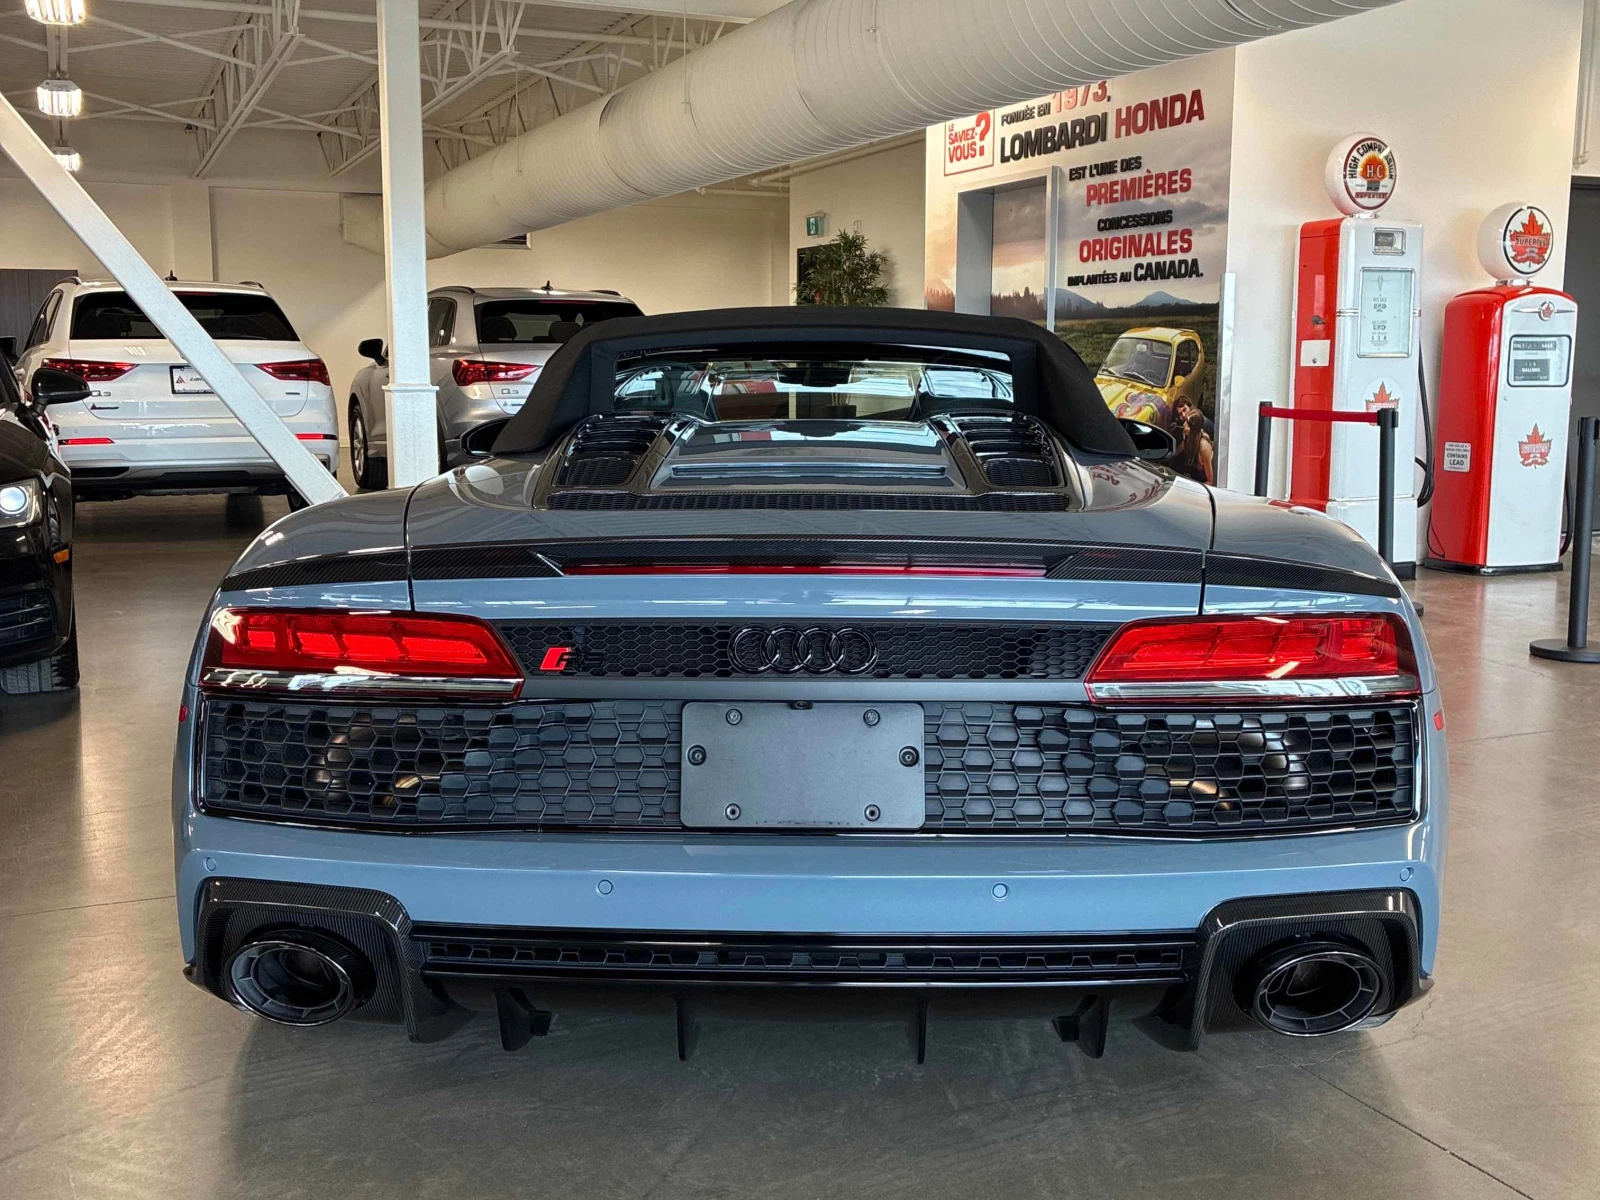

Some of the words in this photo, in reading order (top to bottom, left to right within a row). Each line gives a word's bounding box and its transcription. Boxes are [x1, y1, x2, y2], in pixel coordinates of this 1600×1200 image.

[1001, 105, 1036, 126] FONDÉE
[1037, 102, 1051, 118] EN
[948, 124, 955, 132] LE
[948, 127, 978, 145] SAVIEZ-
[1000, 112, 1108, 164] LOMBARDI
[1114, 89, 1205, 139] HONDA
[948, 141, 977, 163] VOUS
[1069, 165, 1088, 181] EST
[1089, 160, 1118, 177] L'UNE
[1120, 155, 1142, 173] DES
[1348, 155, 1361, 179] HIGH
[1086, 168, 1192, 207] PREMIÈRES
[1097, 209, 1173, 231] CONCESSIONS
[1079, 228, 1193, 263] ORIGINALES
[1067, 269, 1118, 286] IMPLANTÉES
[1119, 271, 1132, 283] AU
[1133, 258, 1204, 282] CANADA.
[1449, 458, 1465, 466] LEAD
